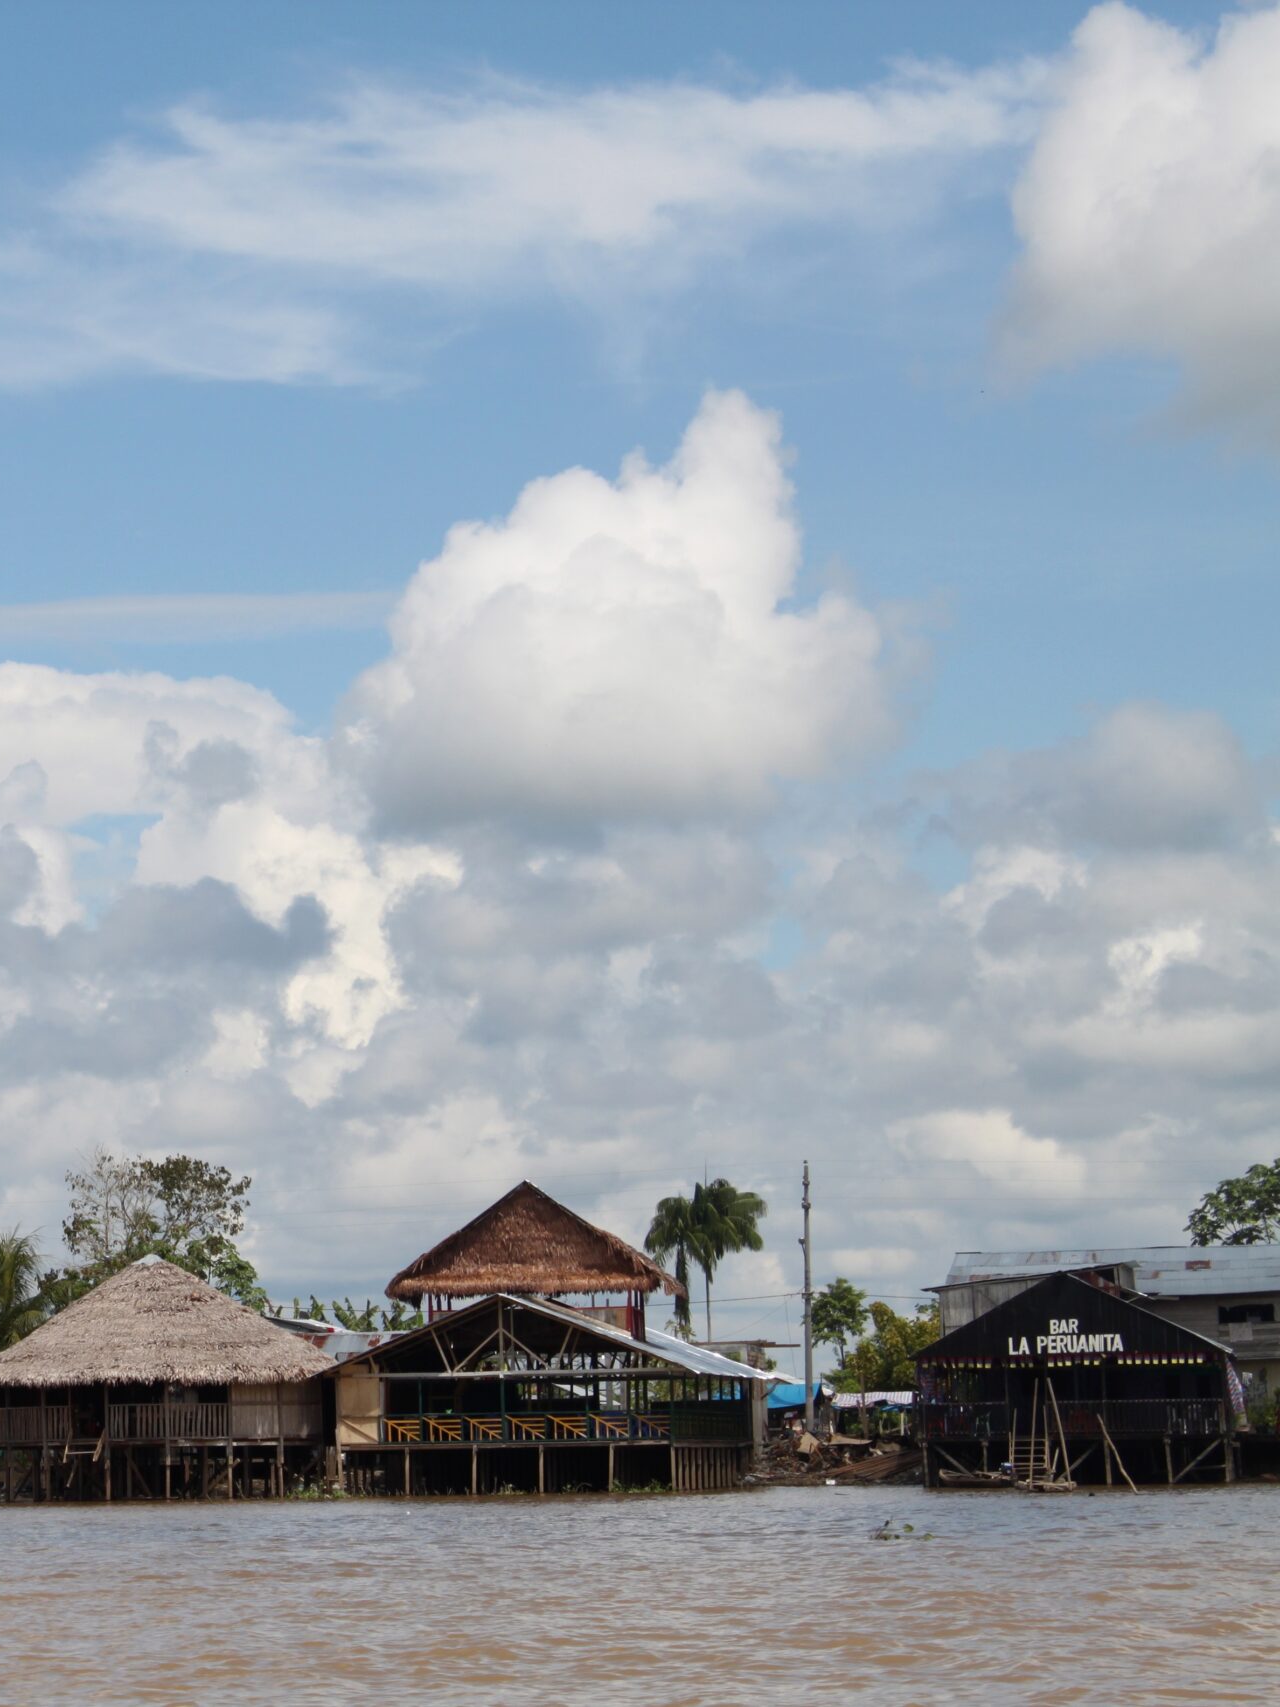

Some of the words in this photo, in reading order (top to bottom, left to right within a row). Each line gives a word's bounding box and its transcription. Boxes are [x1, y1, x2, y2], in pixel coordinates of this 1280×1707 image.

[1049, 1318, 1079, 1335] BAR
[1008, 1336, 1031, 1356] LA
[1036, 1333, 1124, 1354] PERUANITA
